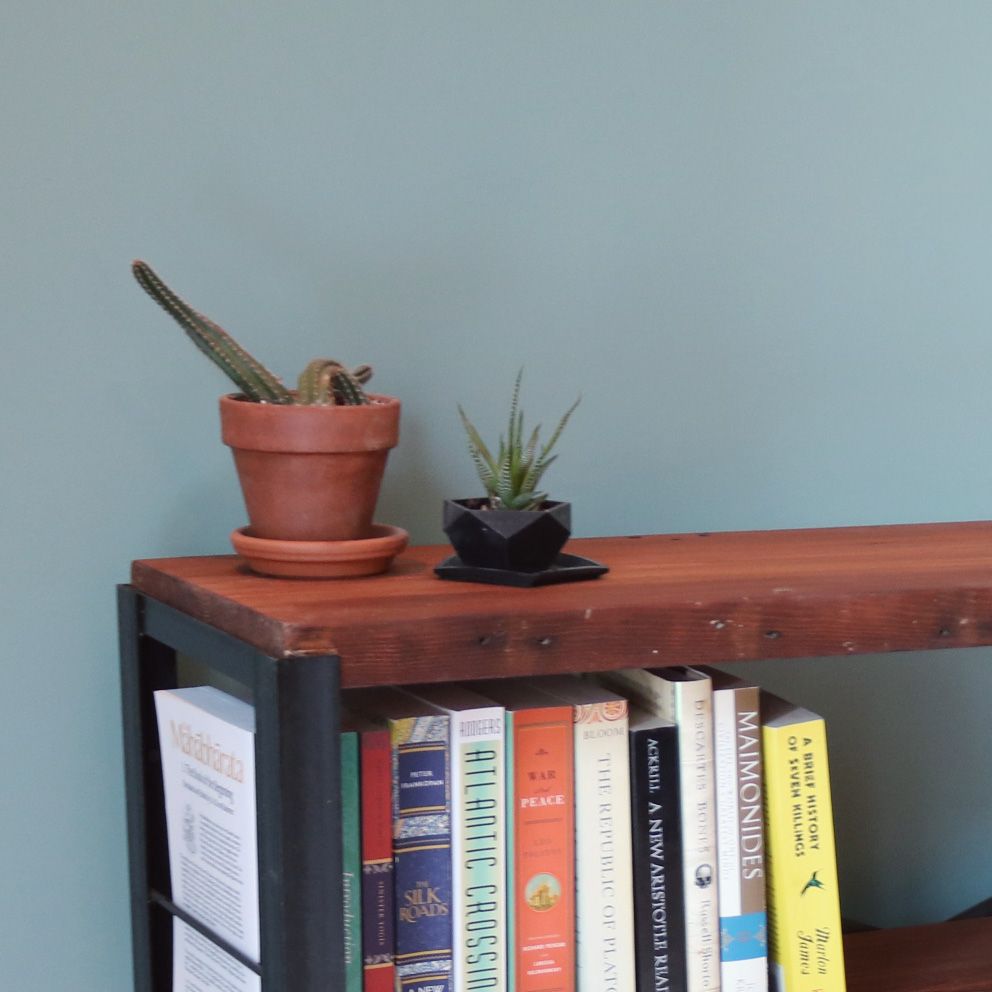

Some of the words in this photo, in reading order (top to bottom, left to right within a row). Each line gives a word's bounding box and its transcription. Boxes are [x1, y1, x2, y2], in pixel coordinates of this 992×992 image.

[787, 735, 798, 751] OF
[803, 737, 812, 746] A
[528, 770, 556, 781] WAR
[598, 753, 612, 796] THE
[789, 758, 802, 798] SEVEN
[803, 752, 815, 788] BRIEF
[464, 749, 497, 870] ATLANTIC
[520, 794, 566, 808] PEACE
[648, 801, 662, 815] A
[737, 711, 763, 880] MAIMONIDES
[649, 819, 665, 860] NEW
[792, 803, 806, 858] KILLINGS
[807, 794, 820, 850] HISTORY
[600, 803, 616, 898] REPUBLIC
[400, 903, 448, 923] ROADS
[404, 887, 442, 905] SILK
[650, 863, 668, 951] ARISTOTLE
[603, 905, 617, 929] OF
[797, 929, 814, 975] James
[815, 926, 831, 975] Marlon
